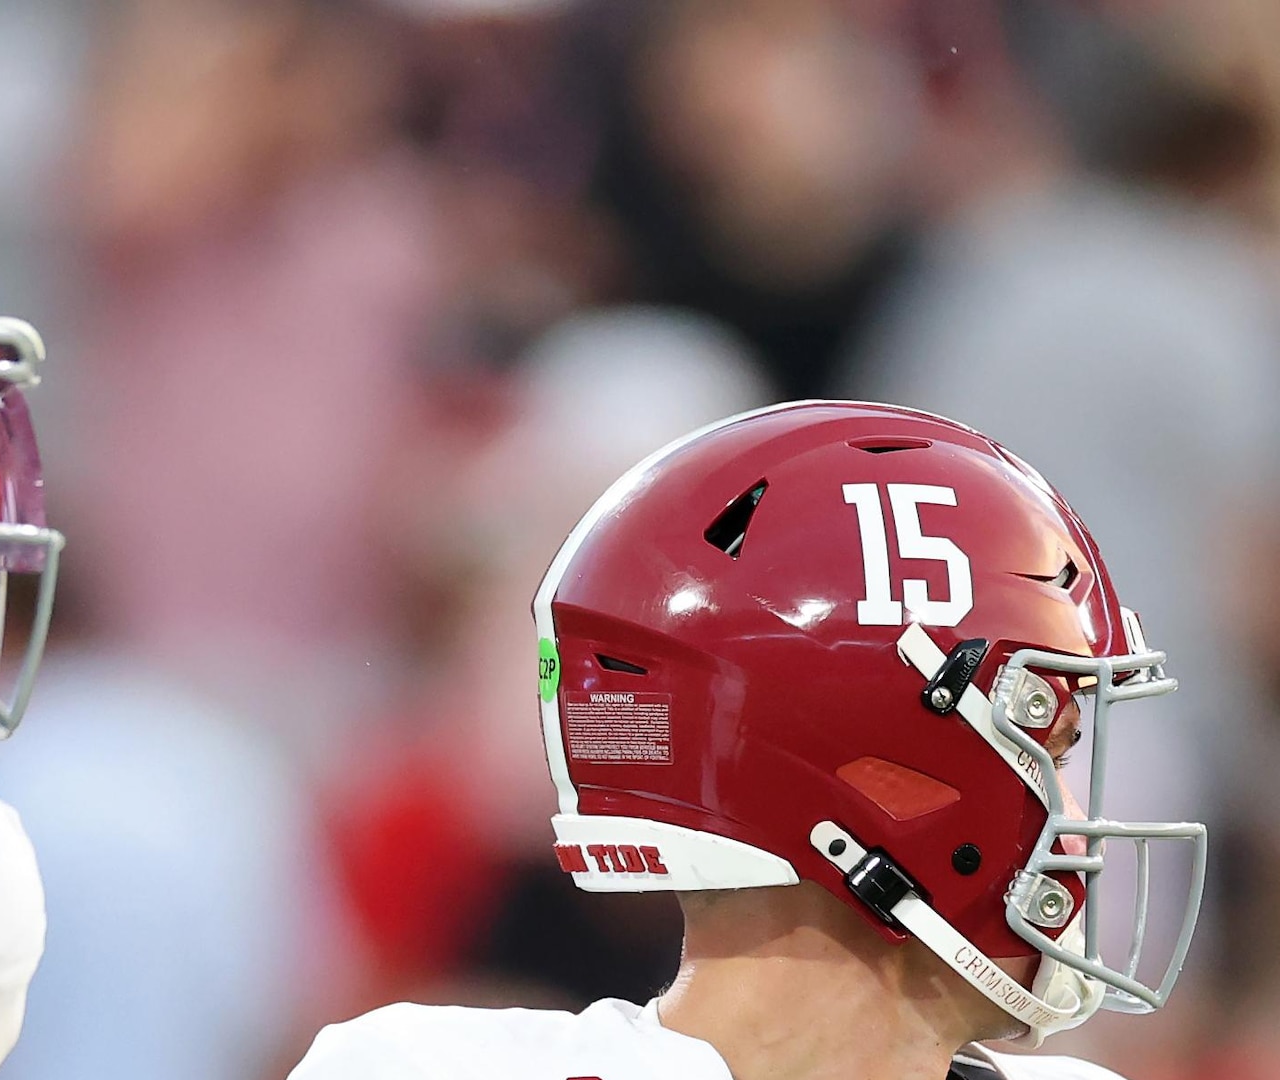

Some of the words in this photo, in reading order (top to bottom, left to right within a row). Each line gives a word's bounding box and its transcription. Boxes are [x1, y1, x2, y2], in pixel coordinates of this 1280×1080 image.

[841, 482, 975, 629] 15
[589, 692, 635, 704] WARNING
[586, 844, 669, 875] TIDE
[954, 946, 1030, 1013] CRIMSON
